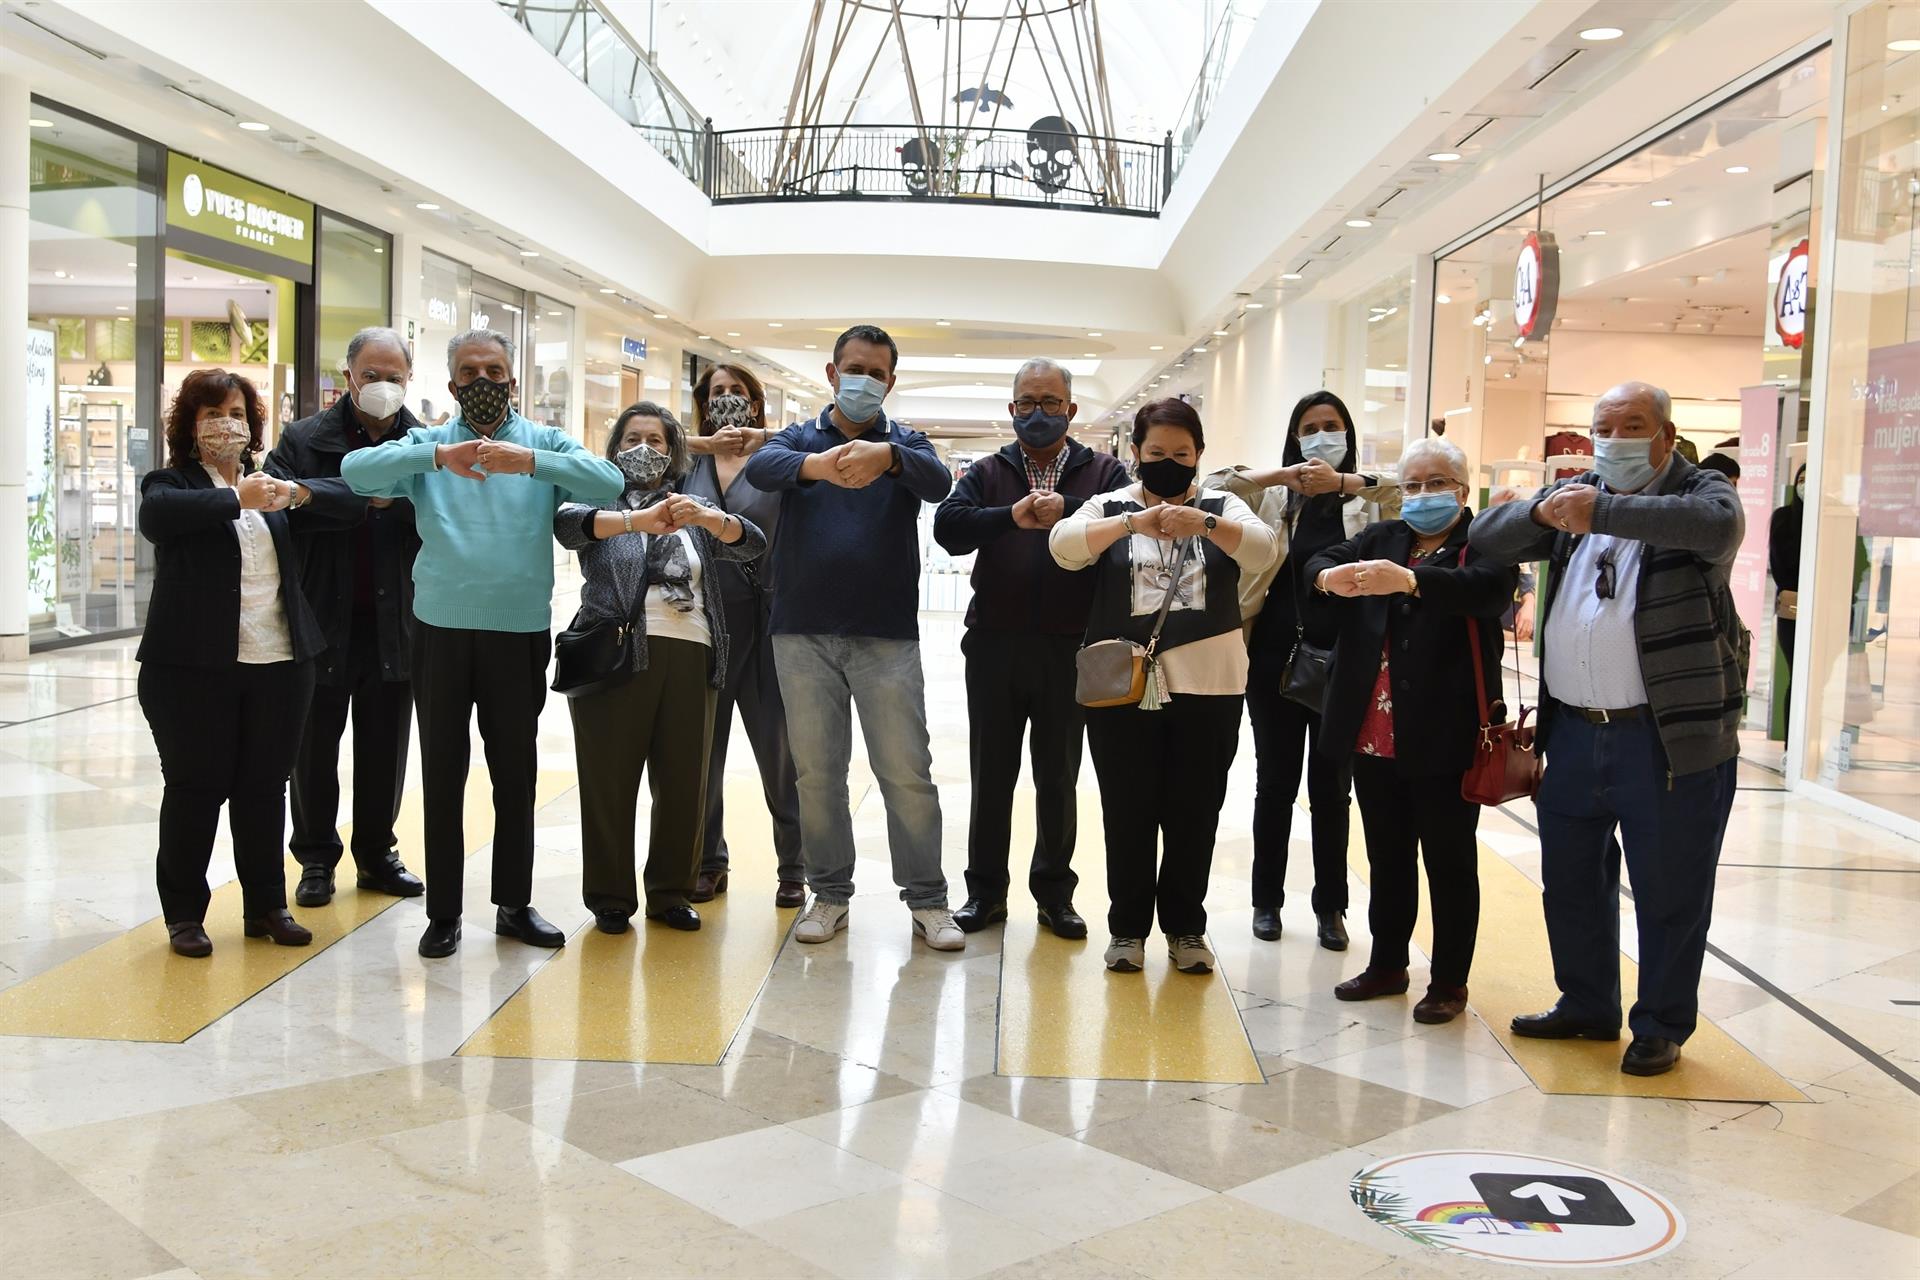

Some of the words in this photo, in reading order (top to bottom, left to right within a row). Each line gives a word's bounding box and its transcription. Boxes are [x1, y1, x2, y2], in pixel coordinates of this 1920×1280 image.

[205, 188, 245, 221] YVES
[247, 202, 304, 240] ROCHER
[236, 225, 275, 245] FRANCE
[1761, 433, 1770, 456] 8
